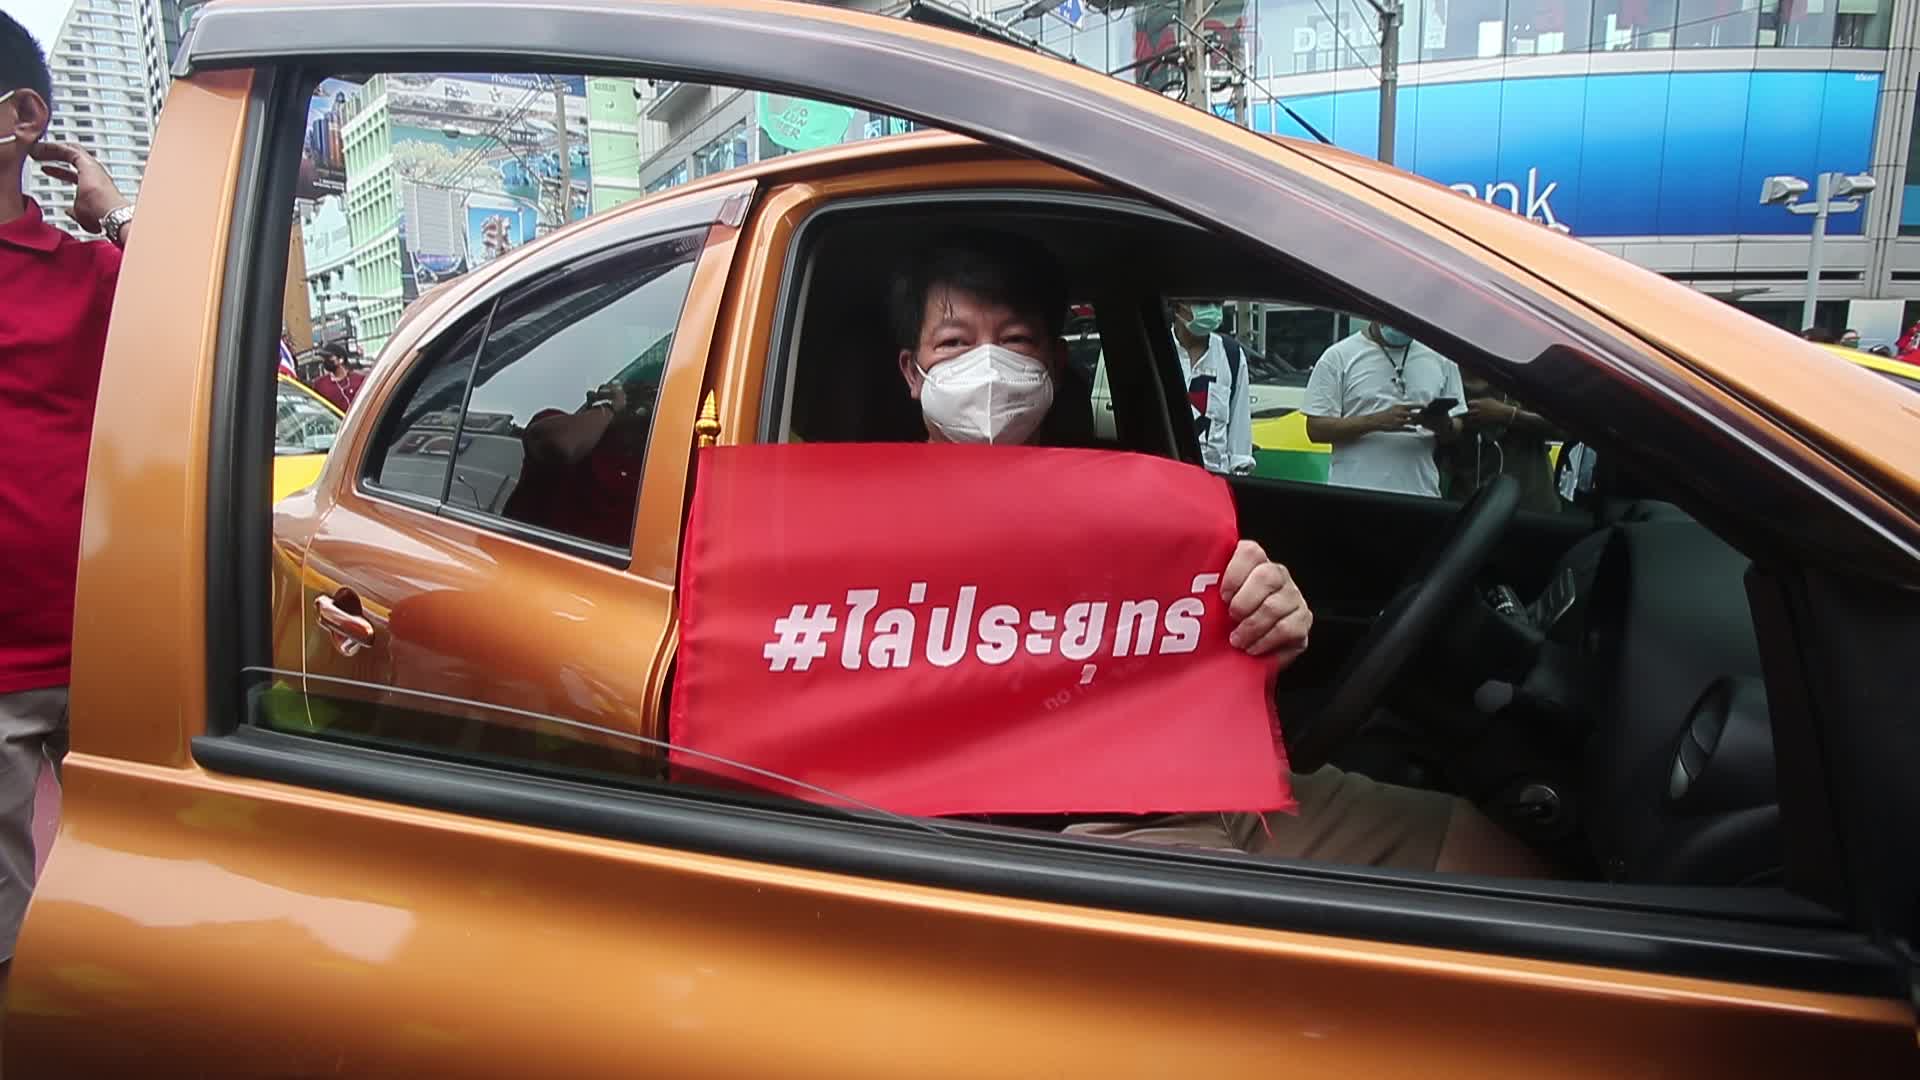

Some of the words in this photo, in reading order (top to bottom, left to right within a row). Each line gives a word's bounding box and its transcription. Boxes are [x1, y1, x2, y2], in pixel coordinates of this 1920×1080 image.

[763, 573, 1220, 685] #ไล่ประยุทธ์
